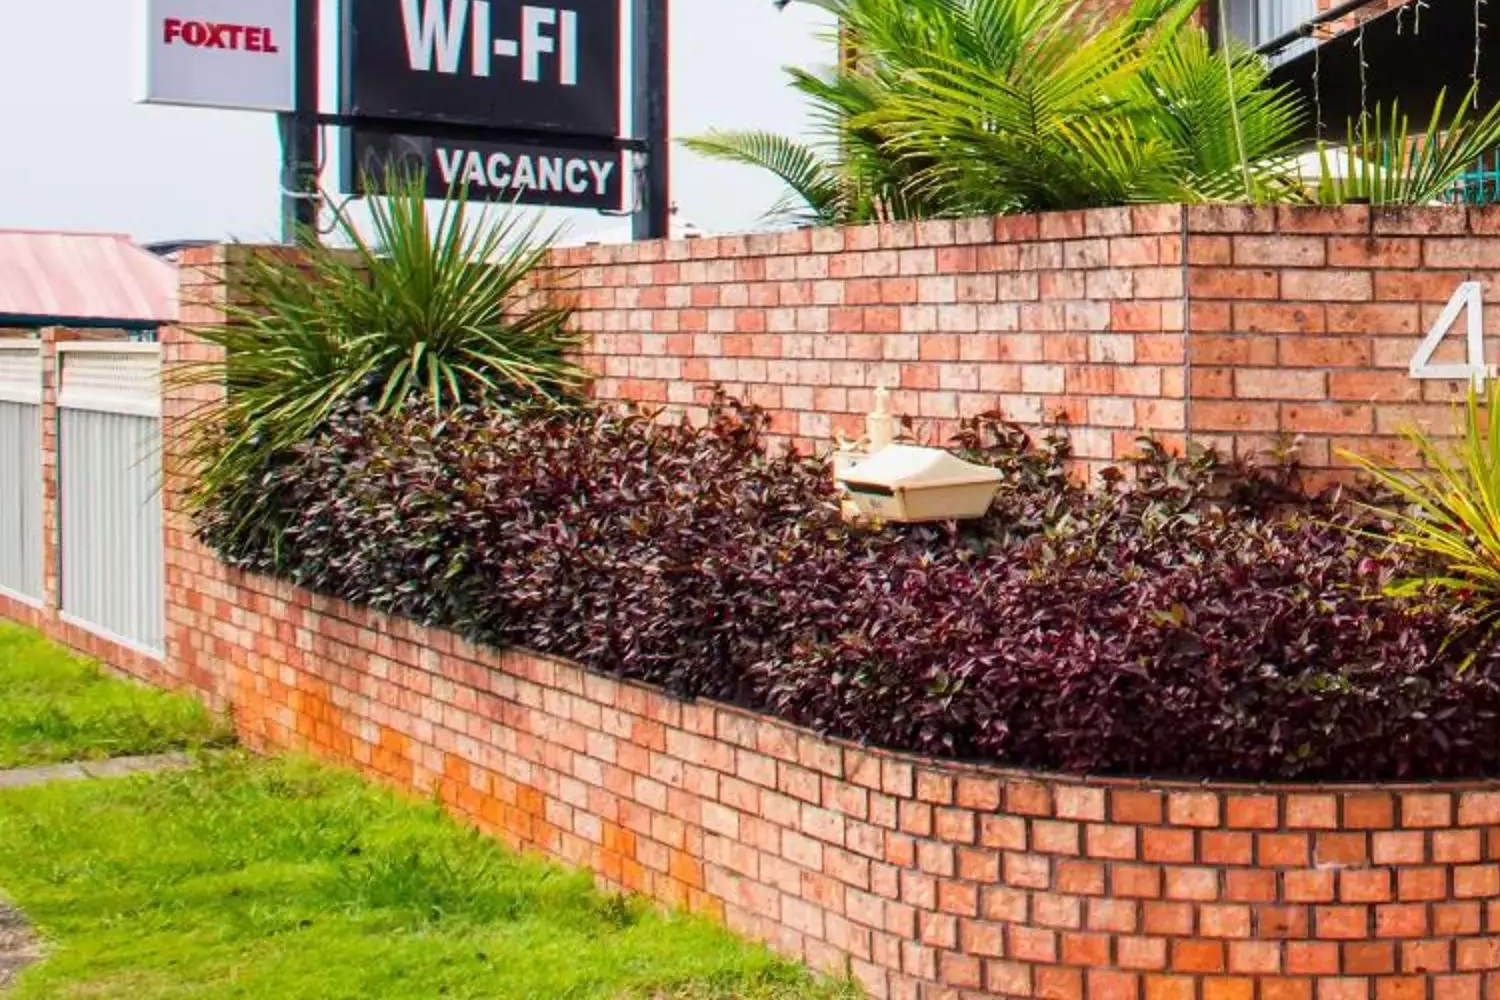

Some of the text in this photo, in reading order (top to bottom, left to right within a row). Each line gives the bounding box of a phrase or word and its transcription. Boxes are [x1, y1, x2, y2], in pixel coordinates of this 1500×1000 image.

[163, 17, 279, 53] FOXTEL
[435, 148, 614, 197] VACANCY
[1409, 280, 1498, 395] 4
